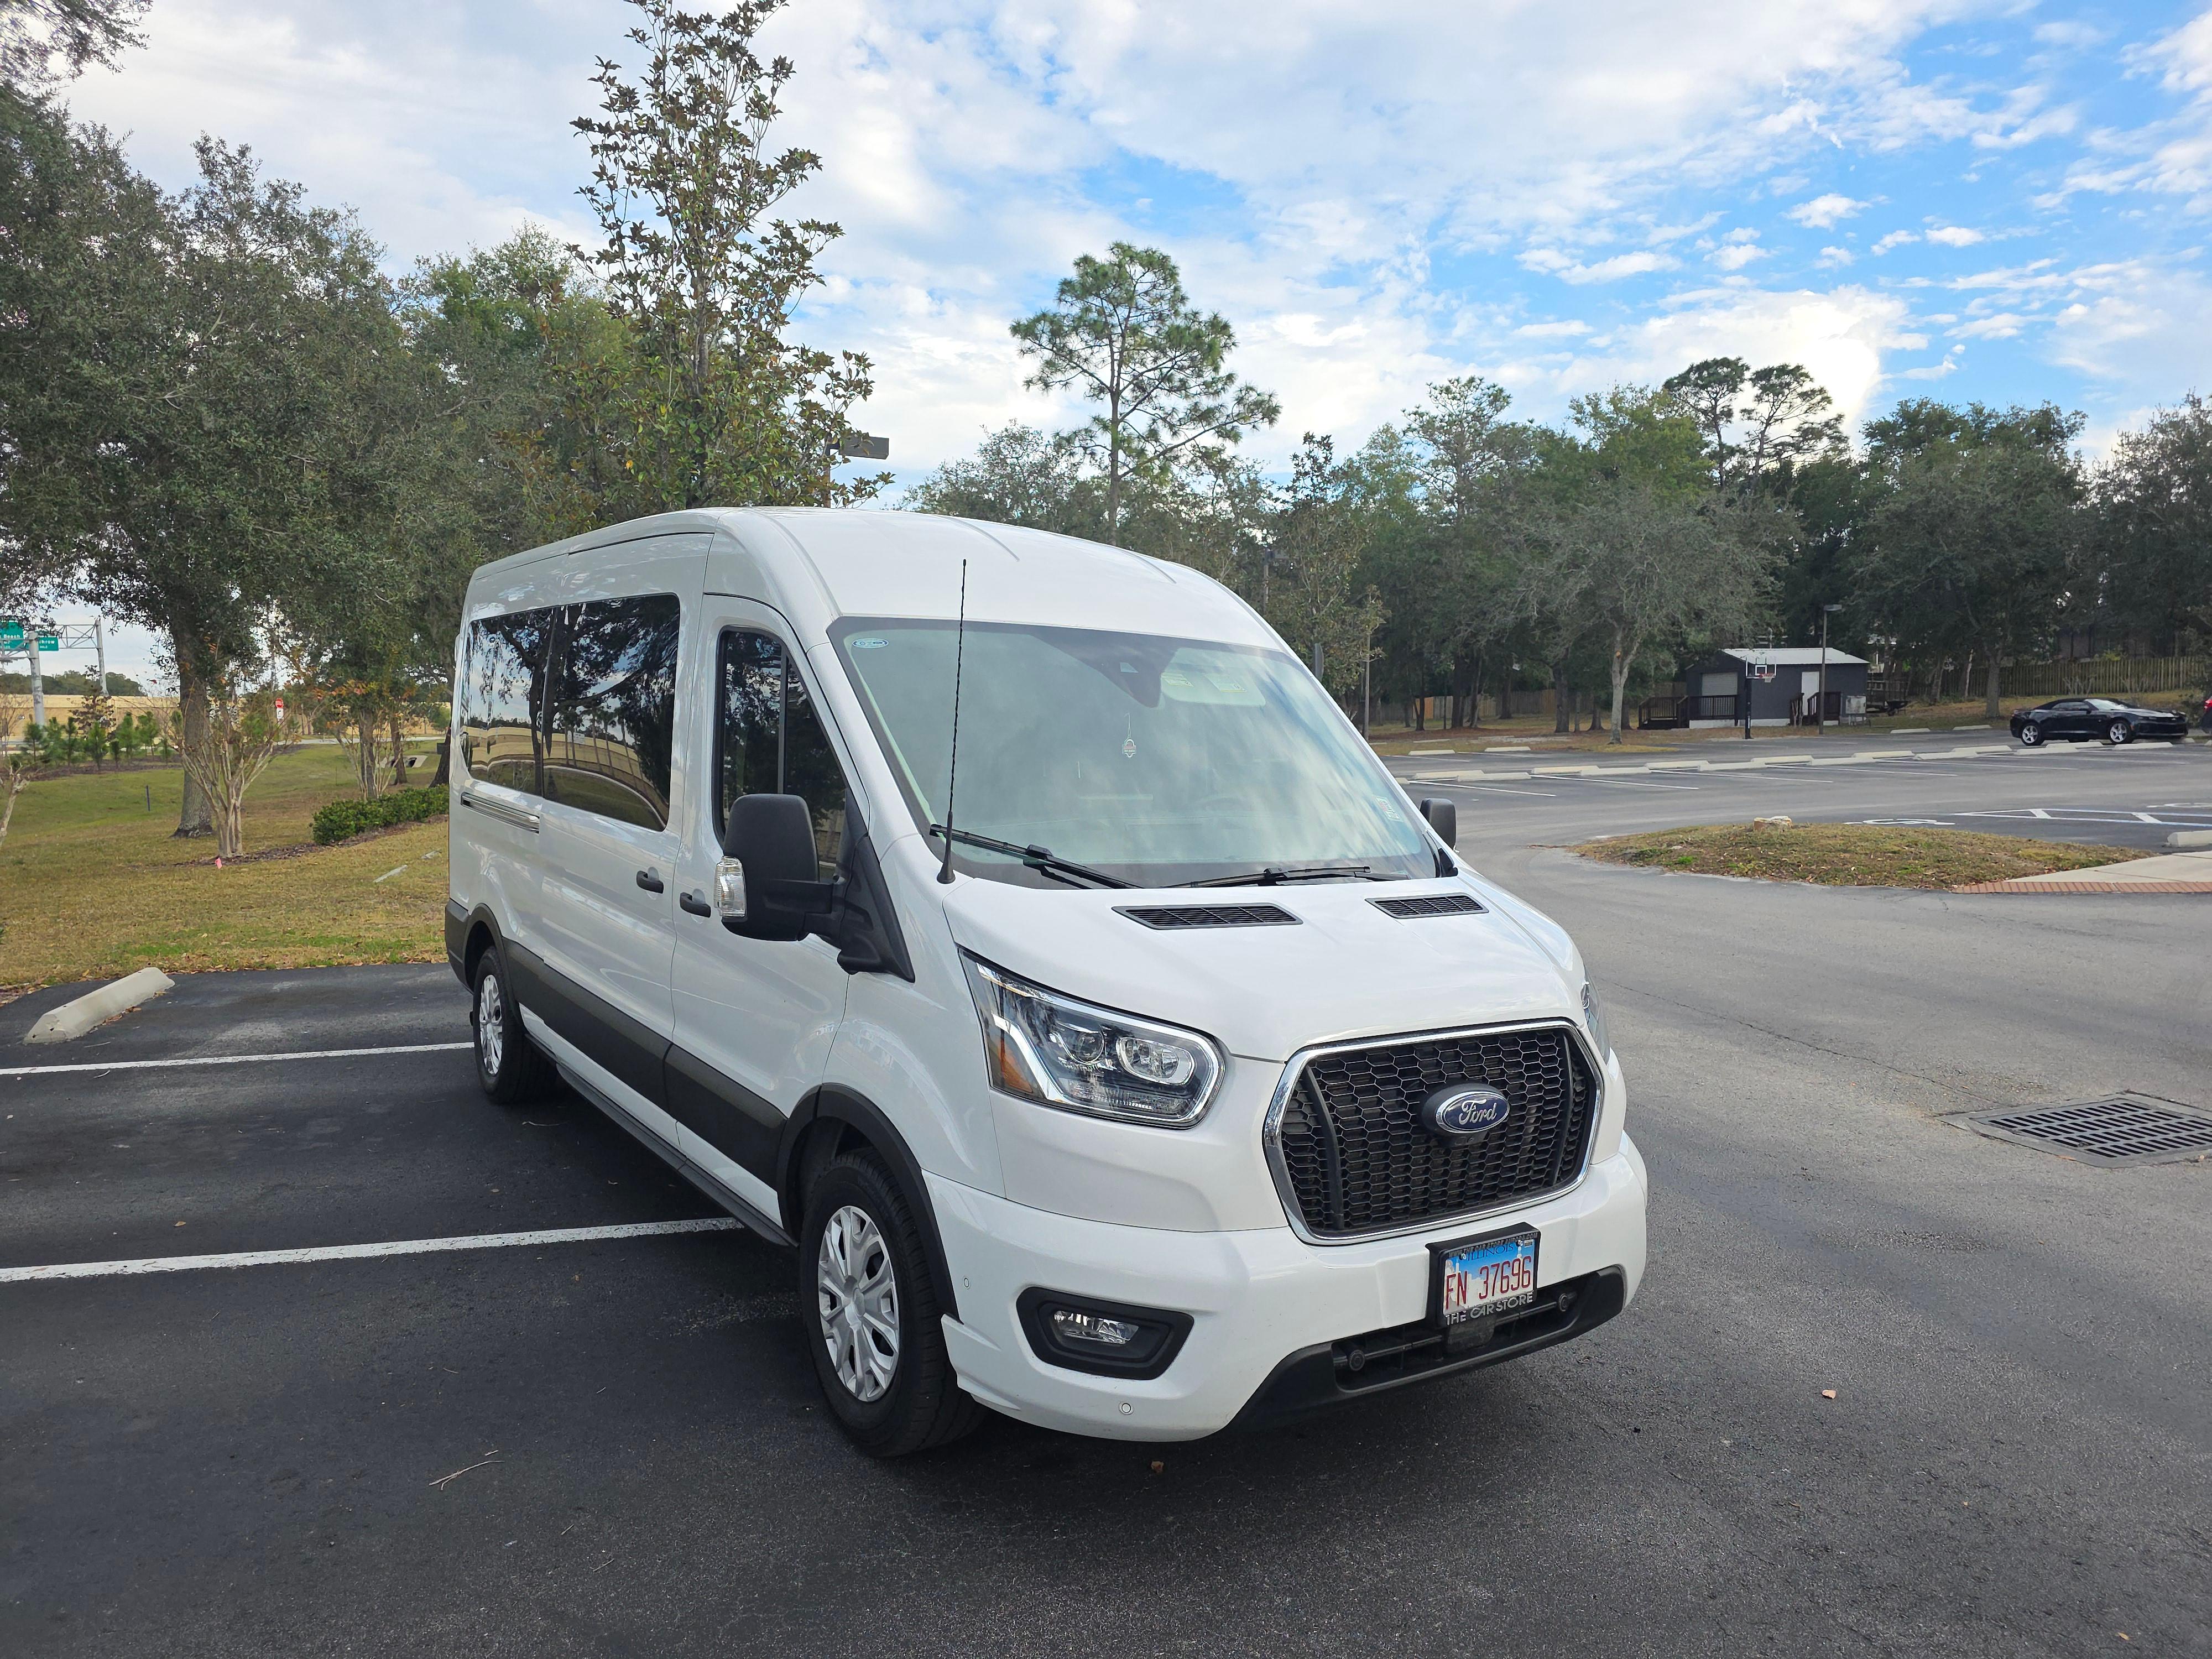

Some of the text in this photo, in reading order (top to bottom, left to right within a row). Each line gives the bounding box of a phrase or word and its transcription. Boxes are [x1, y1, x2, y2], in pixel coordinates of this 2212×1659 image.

[1458, 1099, 1497, 1125] Ford
[1468, 1244, 1514, 1261] ILLINOIS
[1446, 1256, 1532, 1310] FN 37696
[1445, 1292, 1533, 1326] THE CAR STORE
